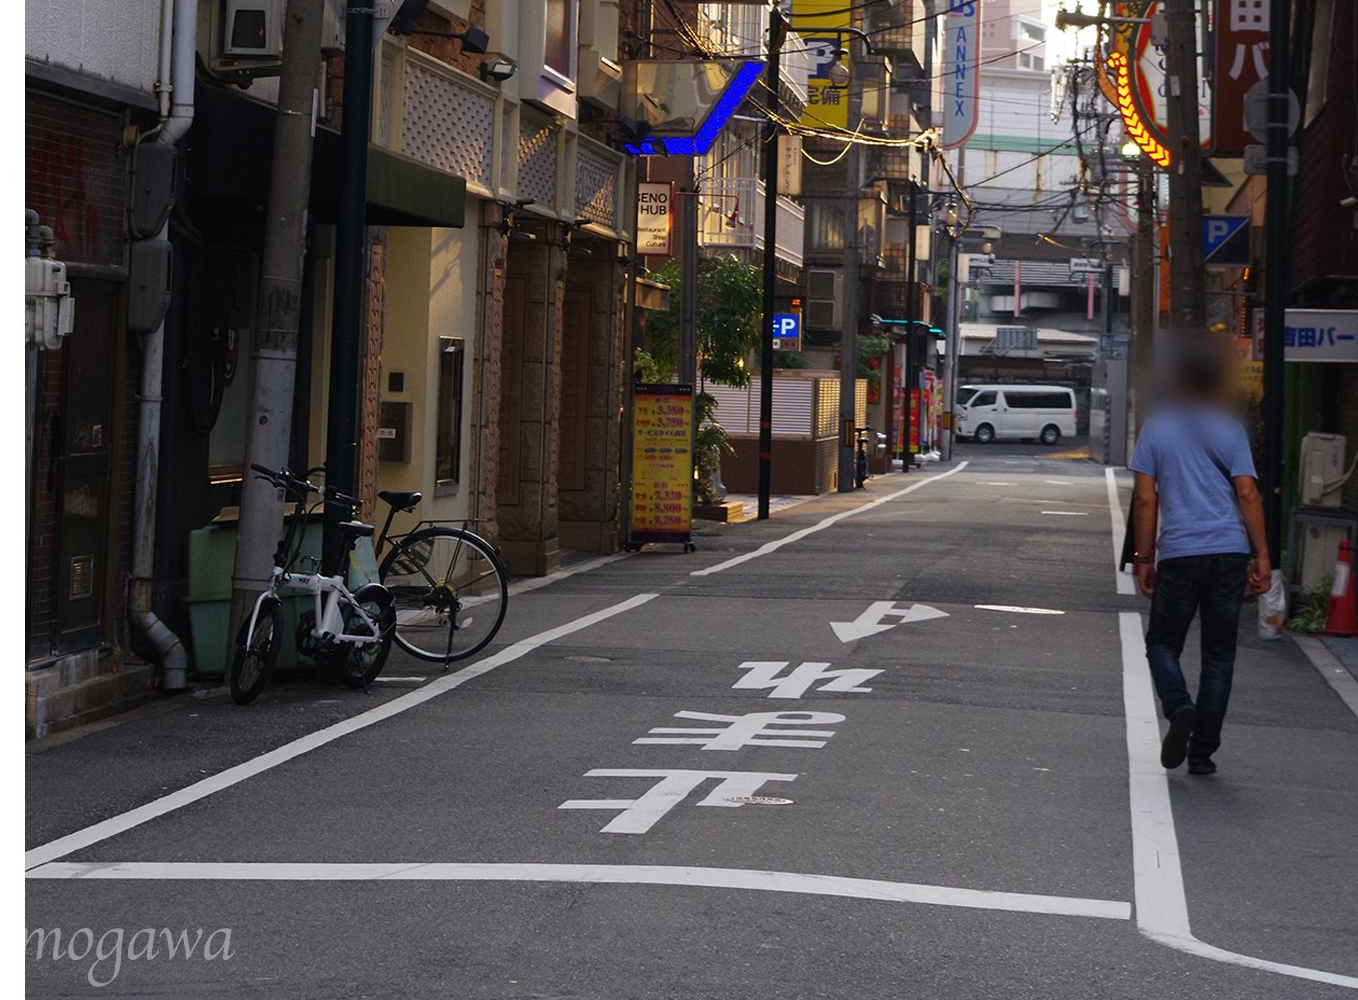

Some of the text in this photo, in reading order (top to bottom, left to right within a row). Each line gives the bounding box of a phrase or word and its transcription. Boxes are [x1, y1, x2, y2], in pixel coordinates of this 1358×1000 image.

[954, 26, 968, 118] ANNEX
[640, 205, 667, 215] HUB
[1207, 220, 1229, 243] P
[781, 318, 796, 335] P
